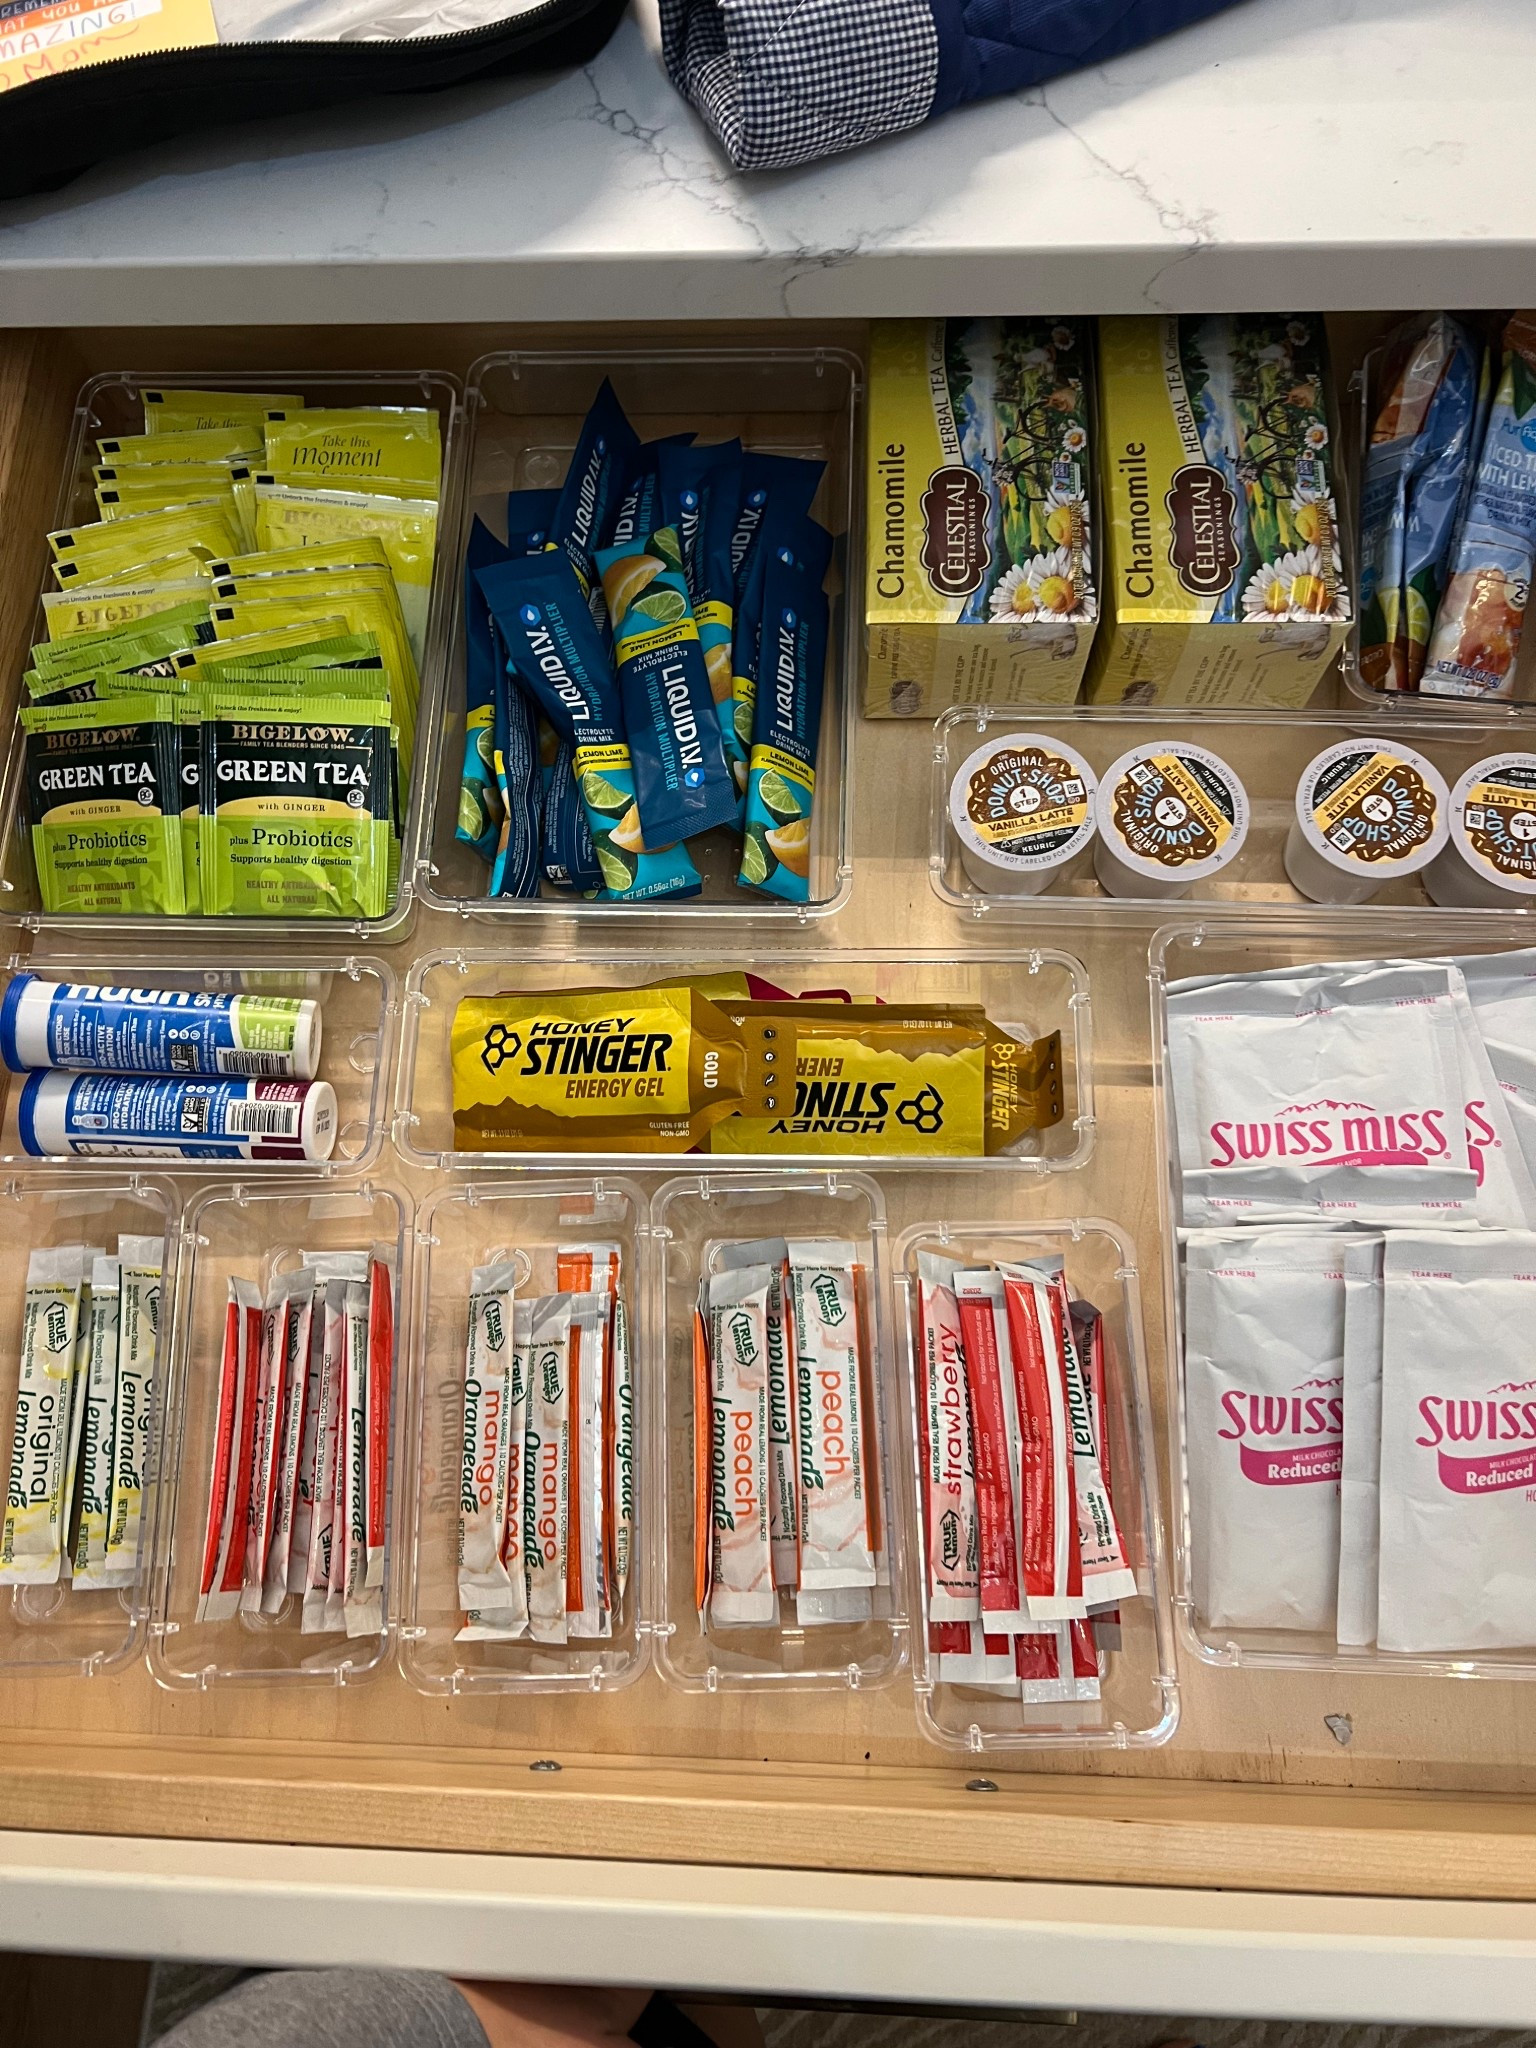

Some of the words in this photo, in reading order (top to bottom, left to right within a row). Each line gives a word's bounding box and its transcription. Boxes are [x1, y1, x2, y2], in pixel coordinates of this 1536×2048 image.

[930, 366, 947, 395] TEA
[1165, 363, 1185, 393] TEA
[322, 435, 347, 447] Take
[350, 435, 371, 448] this
[935, 397, 959, 456] HERBAL
[1174, 395, 1201, 455] HERBAL
[293, 447, 381, 468] Moment
[877, 443, 905, 599] Chamomile
[939, 477, 970, 585] CELESTIAL
[969, 498, 977, 563] SEASONINGS
[1118, 442, 1154, 598] Chamomile
[1189, 475, 1221, 584] CELESTIAL
[1214, 496, 1227, 562] SEASONINGS
[525, 625, 555, 656] I.V.
[545, 602, 581, 665] MULTIPLIER
[778, 626, 795, 656] I.V.
[632, 650, 688, 674] ELECTROLYTE
[540, 655, 590, 720] LIQUID
[572, 665, 602, 721] HYDRATION
[661, 663, 698, 743] LIQUID
[776, 654, 795, 732] LIQUID
[46, 727, 139, 749] BIGELOW
[231, 724, 355, 743] BIGELOW
[240, 740, 263, 748] FAMILY
[577, 735, 598, 743] DRINK
[599, 734, 613, 742] MIX
[645, 672, 667, 732] HYDRATION
[657, 732, 679, 791] MULTIPLIER
[769, 729, 811, 757] ELECTROLYTE
[578, 750, 604, 760] LEMON
[605, 748, 624, 758] LIME
[679, 741, 703, 770] I.V.
[769, 751, 794, 769] LEMON
[795, 762, 810, 777] LIME
[990, 756, 1044, 776] ORIGINAL
[38, 765, 104, 791] GREEN
[108, 762, 157, 786] TEA
[216, 759, 306, 783] GREEN
[313, 762, 370, 786] TEA
[1161, 765, 1189, 792] LATTE
[1203, 770, 1228, 797] KEURIG
[1320, 760, 1348, 785] KEURIG
[1351, 764, 1391, 797] VANILLA
[69, 808, 86, 816] with
[88, 805, 121, 815] GINGER
[257, 802, 279, 811] with
[283, 803, 326, 812] GINGER
[987, 768, 1023, 819] DONUT
[1027, 768, 1066, 805] SHOP
[1014, 797, 1039, 809] STEP
[1019, 788, 1027, 798] 1
[1134, 777, 1164, 819] SHOP
[1165, 799, 1184, 820] STEP
[1326, 795, 1354, 821] LATTE
[1365, 797, 1384, 814] STEP
[1382, 777, 1416, 833] DONUT
[1482, 793, 1518, 806] LATTE
[988, 816, 1037, 832] VANILLA
[1040, 807, 1074, 821] LATTE
[1186, 793, 1220, 833] VANILLA
[1342, 817, 1391, 842] SHOP
[1485, 808, 1518, 853] SHOP
[52, 843, 67, 853] plus
[67, 831, 147, 850] Probiotics
[230, 835, 249, 846] plus
[251, 828, 353, 848] Probiotics
[973, 836, 988, 851] THIS
[987, 847, 1004, 858] UNIT
[1004, 855, 1018, 864] NOT
[1020, 855, 1052, 865] LABELED
[1053, 848, 1066, 859] FOR
[1066, 832, 1086, 851] RETAIL
[1082, 815, 1094, 833] SALE
[1021, 841, 1056, 853] KEURIG
[1120, 809, 1160, 854] ORIGINAL
[1140, 821, 1206, 846] DONUT
[1383, 814, 1429, 853] ORIGINAL
[54, 860, 84, 870] Supports
[85, 858, 112, 868] healthy
[114, 856, 148, 866] digestion
[230, 854, 272, 864] Supports
[273, 854, 309, 866] healthy
[311, 856, 352, 867] digestion
[529, 1017, 636, 1036] HONEY
[520, 1033, 673, 1076] STINGER
[703, 1051, 719, 1089] GOLD
[796, 1057, 844, 1077] ENER
[566, 1078, 632, 1099] ENERGY
[634, 1077, 665, 1097] GEL
[991, 1060, 1010, 1131] STINGER
[1008, 1062, 1018, 1114] HONEY
[112, 1082, 128, 1130] PRO-ACTIVE
[120, 1083, 137, 1130] HYDRATION
[767, 1120, 886, 1134] HONEY
[1210, 1119, 1333, 1167] SWISS
[1341, 1109, 1448, 1156] MISS
[815, 1284, 830, 1319] lemon
[823, 1279, 843, 1317] TRUE
[47, 1312, 56, 1347] lemon
[54, 1306, 67, 1344] TRUE
[491, 1304, 503, 1342] TRUE
[739, 1318, 755, 1356] TRUE
[927, 1327, 935, 1349] PACKET
[732, 1323, 745, 1359] lemon
[548, 1357, 560, 1394] TRUE
[931, 1391, 937, 1399] 10
[939, 1323, 962, 1496] strawberry
[119, 1371, 142, 1490] Lemonade
[798, 1356, 823, 1490] Lemonade
[815, 1371, 850, 1475] peach
[929, 1404, 938, 1430] LEMONS
[1217, 1390, 1343, 1440] SWISS
[8, 1390, 37, 1510] Lemonade
[29, 1395, 54, 1503] original
[461, 1378, 482, 1514] Orangeade
[476, 1390, 500, 1506] mango
[931, 1430, 939, 1444] REAL
[932, 1444, 940, 1465] FROM
[82, 1397, 107, 1515] Lemonade
[712, 1397, 735, 1532] Lemonade
[730, 1412, 757, 1516] peach
[1268, 1459, 1342, 1479] Reduced
[933, 1467, 941, 1483] MADE
[1466, 1465, 1533, 1488] Reduced
[524, 1431, 544, 1570] Orangeade
[538, 1442, 558, 1561] mango
[943, 1521, 952, 1562] TRUE
